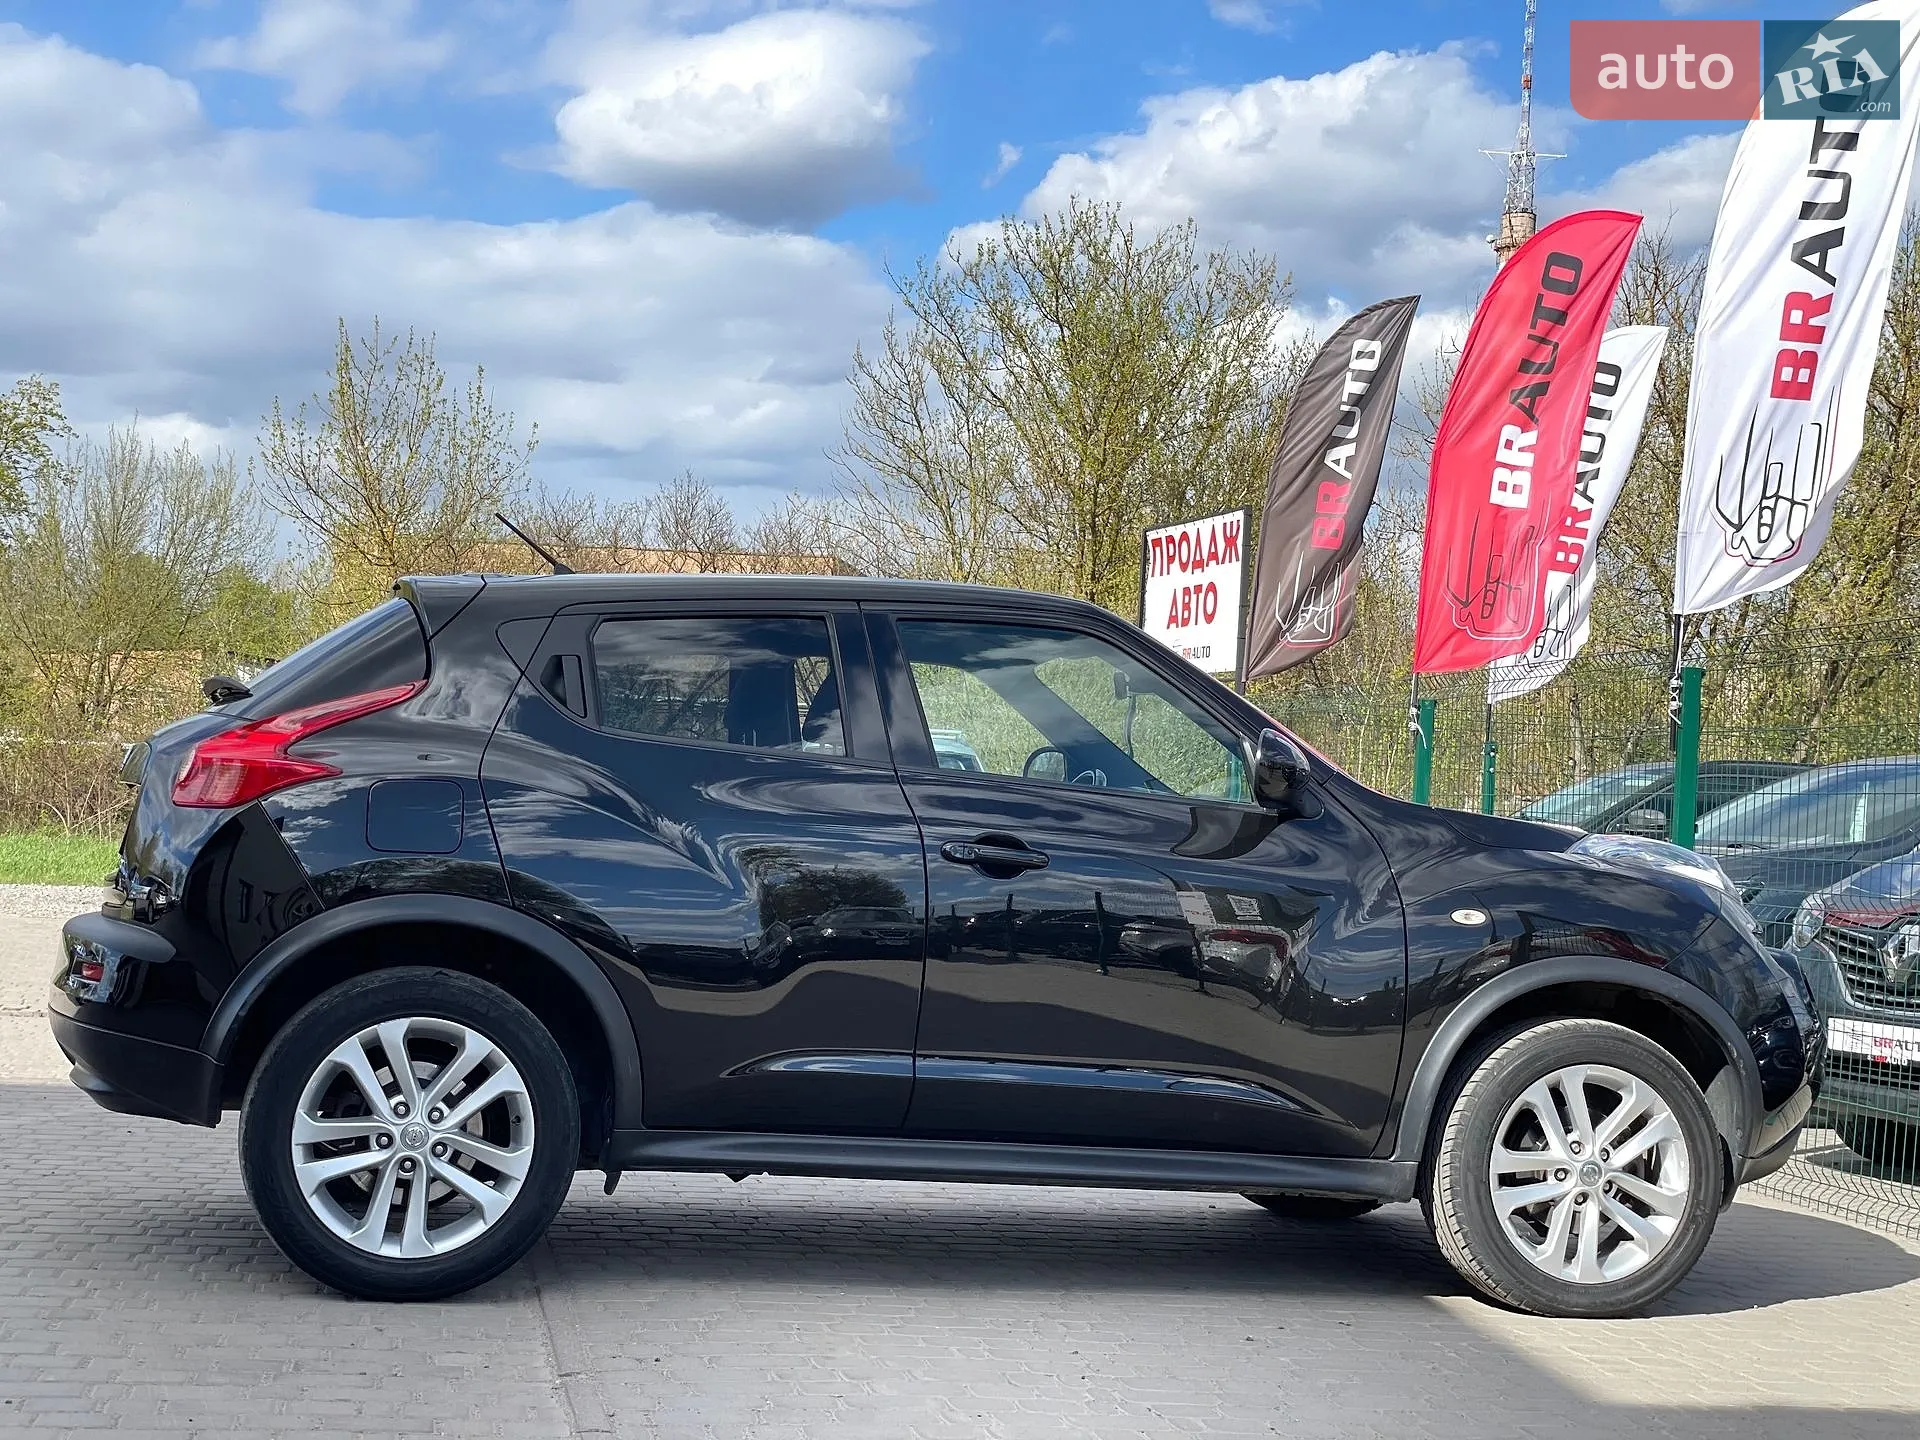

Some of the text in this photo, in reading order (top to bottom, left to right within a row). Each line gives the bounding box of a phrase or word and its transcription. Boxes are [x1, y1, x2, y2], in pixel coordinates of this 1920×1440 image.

[1311, 338, 1382, 551] BRAUTO
[1489, 251, 1584, 509] BRAUTO
[1151, 519, 1241, 578] ПРОДАЖ
[1166, 581, 1218, 630] АВТО
